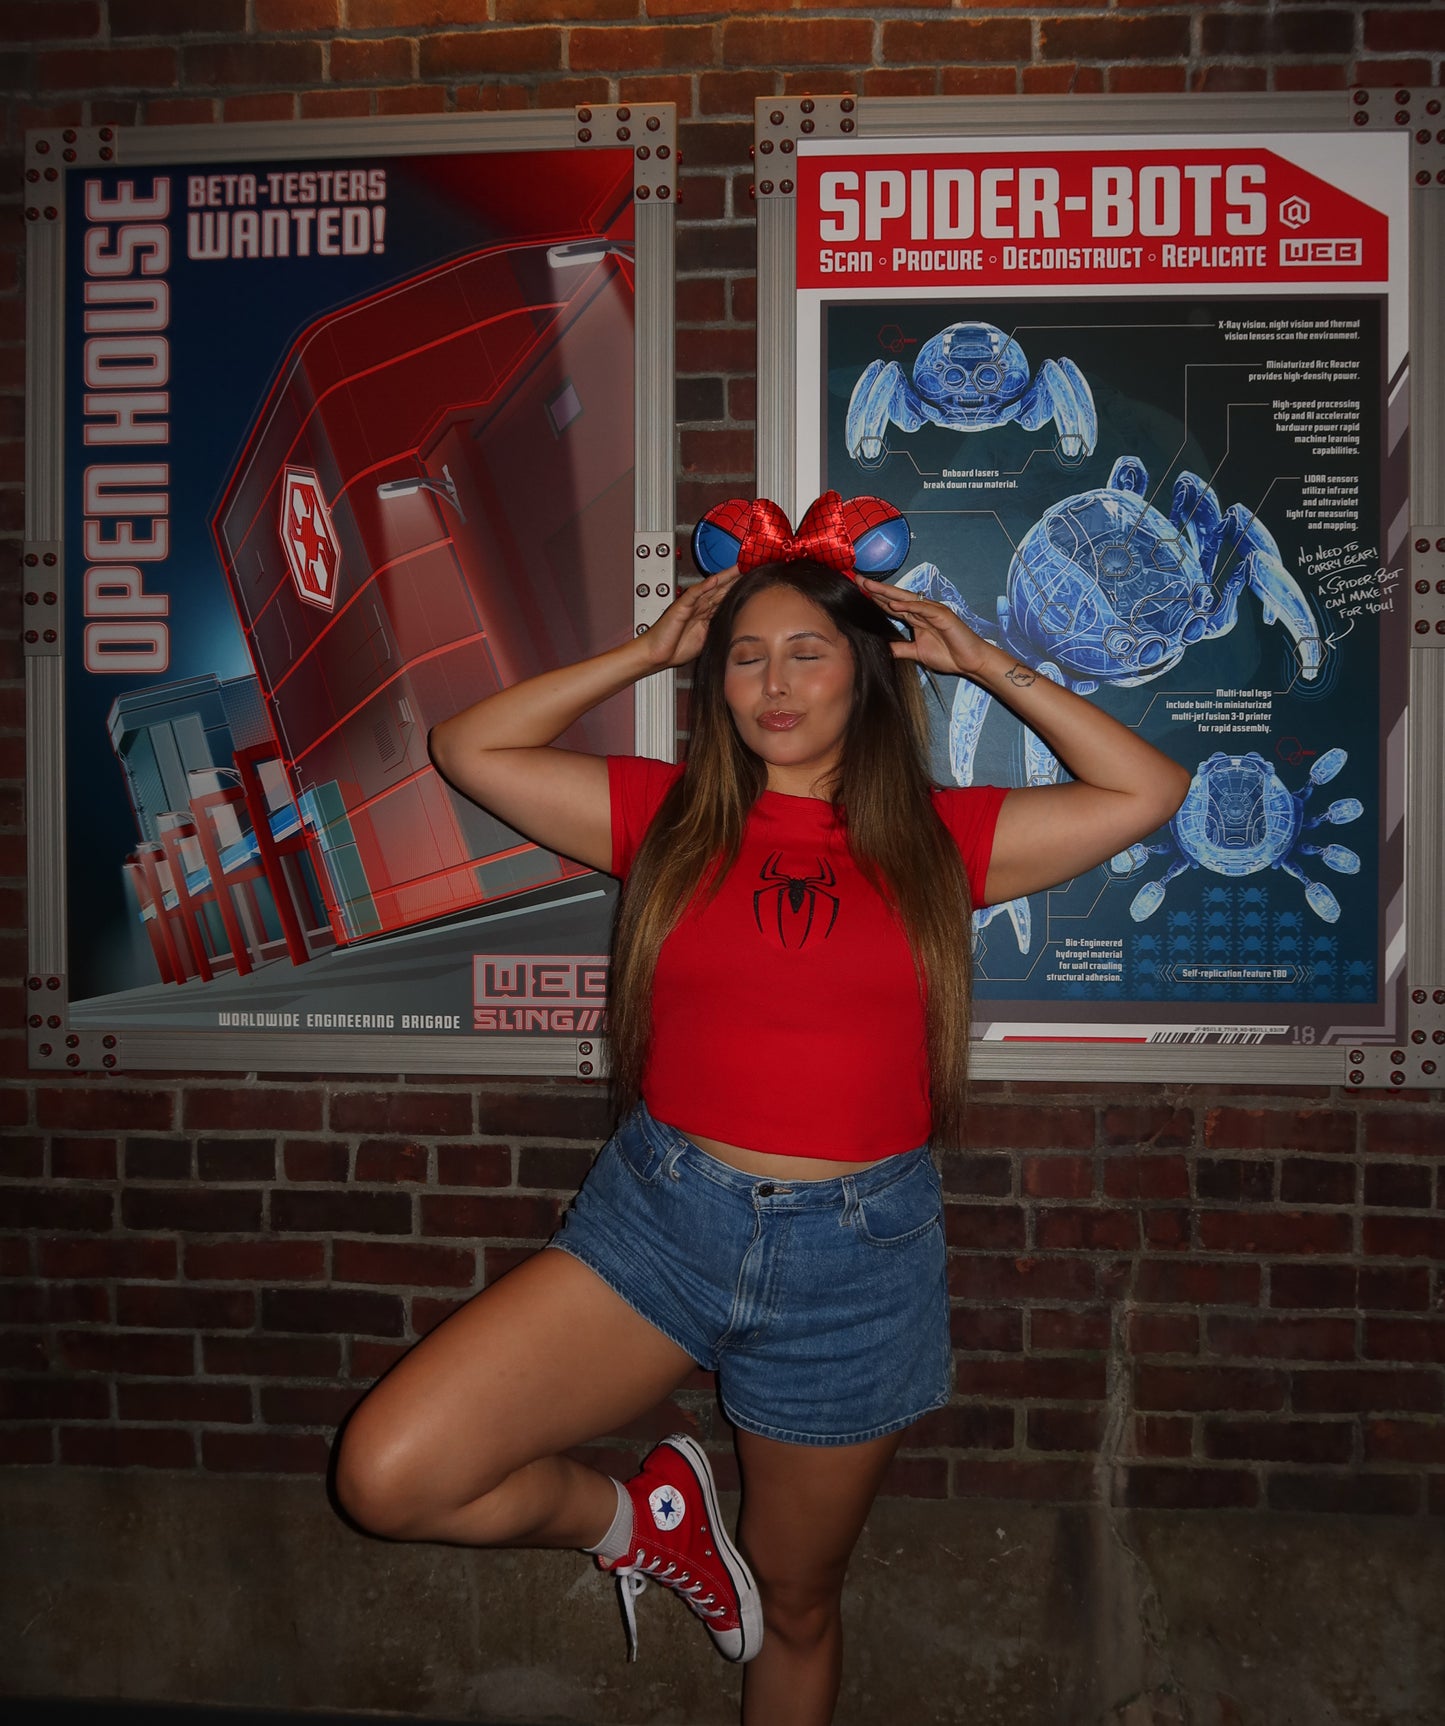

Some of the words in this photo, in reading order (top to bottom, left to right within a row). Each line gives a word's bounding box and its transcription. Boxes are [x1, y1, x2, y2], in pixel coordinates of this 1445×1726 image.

[187, 169, 387, 207] BETA-TESTERS
[819, 164, 1267, 242] SPIDER-BOTS
[1279, 195, 1310, 230] @
[187, 205, 386, 260] WANTED!
[1282, 240, 1360, 264] WEB
[892, 247, 983, 272] PROCURE
[1002, 246, 1143, 270] DECONSTRUCT
[1162, 245, 1267, 268] REPLICATE
[83, 177, 170, 446] HOUSE
[1218, 320, 1241, 330] X-Ray
[1269, 320, 1289, 330] night
[1290, 320, 1314, 328] vision
[1315, 320, 1329, 328] and
[1330, 319, 1360, 328] thermal
[1224, 332, 1248, 340] vision
[1249, 332, 1275, 340] lenses
[1276, 332, 1294, 340] scan
[1296, 332, 1308, 340] the
[1309, 332, 1360, 340] environment.
[1266, 360, 1315, 369] Miniaturized
[1316, 360, 1329, 369] Arc
[1330, 360, 1360, 369] Reactor
[1248, 372, 1282, 382] provides
[1284, 372, 1332, 382] high-density
[1333, 372, 1360, 382] power.
[1272, 400, 1316, 410] High-speed
[1317, 400, 1360, 410] processing
[1273, 412, 1290, 421] chip
[1291, 412, 1305, 420] and
[1315, 412, 1360, 420] accelerator
[1276, 423, 1313, 431] hardware
[1314, 424, 1338, 433] power
[1339, 423, 1360, 433] rapid
[1294, 435, 1327, 443] machine
[1328, 435, 1360, 445] learning
[1312, 446, 1360, 456] capabilities.
[942, 469, 974, 477] Onboard
[975, 469, 999, 477] lasers
[1304, 474, 1326, 483] LIDAR
[1327, 474, 1358, 483] sensors
[923, 481, 945, 489] break
[946, 481, 968, 489] down
[984, 481, 1018, 489] material.
[1302, 486, 1326, 495] utilize
[1327, 486, 1358, 495] infrared
[1302, 498, 1317, 506] and
[1318, 498, 1358, 506] ultraviolet
[1286, 510, 1304, 520] light
[1305, 510, 1317, 518] for
[1317, 510, 1358, 520] measuring
[1308, 521, 1322, 530] and
[1323, 521, 1358, 531] mapping.
[1316, 545, 1342, 561] NEED
[1307, 559, 1341, 575] CARRY
[1344, 547, 1379, 566] GEAR!
[83, 463, 169, 674] OPEN
[1318, 585, 1326, 596] A
[1326, 567, 1404, 595] SPIDER-BOT
[1325, 593, 1346, 609] CAN
[1350, 586, 1380, 602] MAKE
[1383, 584, 1399, 595] IT
[1339, 606, 1363, 619] FOR
[1366, 598, 1394, 614] YOU!
[1216, 688, 1254, 697] Multi-tool
[1255, 688, 1272, 699] legs
[1166, 700, 1194, 709] include
[1195, 700, 1223, 709] built-in
[1223, 700, 1272, 709] miniaturized
[1171, 712, 1204, 722] multi-jet
[1205, 712, 1230, 721] fusion
[1245, 712, 1272, 721] printer
[1198, 724, 1210, 732] for
[1211, 724, 1231, 733] rapid
[1232, 724, 1272, 733] assembly.
[1065, 938, 1123, 949] Bio-Engineered
[1055, 950, 1090, 960] hydrogel
[1090, 950, 1123, 959] material
[1059, 961, 1071, 970] for
[1072, 961, 1088, 970] wall
[1089, 961, 1123, 972] crawling
[1046, 973, 1084, 982] structural
[1085, 973, 1123, 982] adhesion.
[1182, 968, 1242, 979] Self-replication
[1242, 969, 1271, 978] feature
[1272, 969, 1287, 978] TBD
[218, 1012, 300, 1027] WORLDWIDE
[306, 1014, 395, 1028] ENGINEERING
[402, 1015, 460, 1029] BRIGADE
[1291, 1026, 1316, 1045] 18
